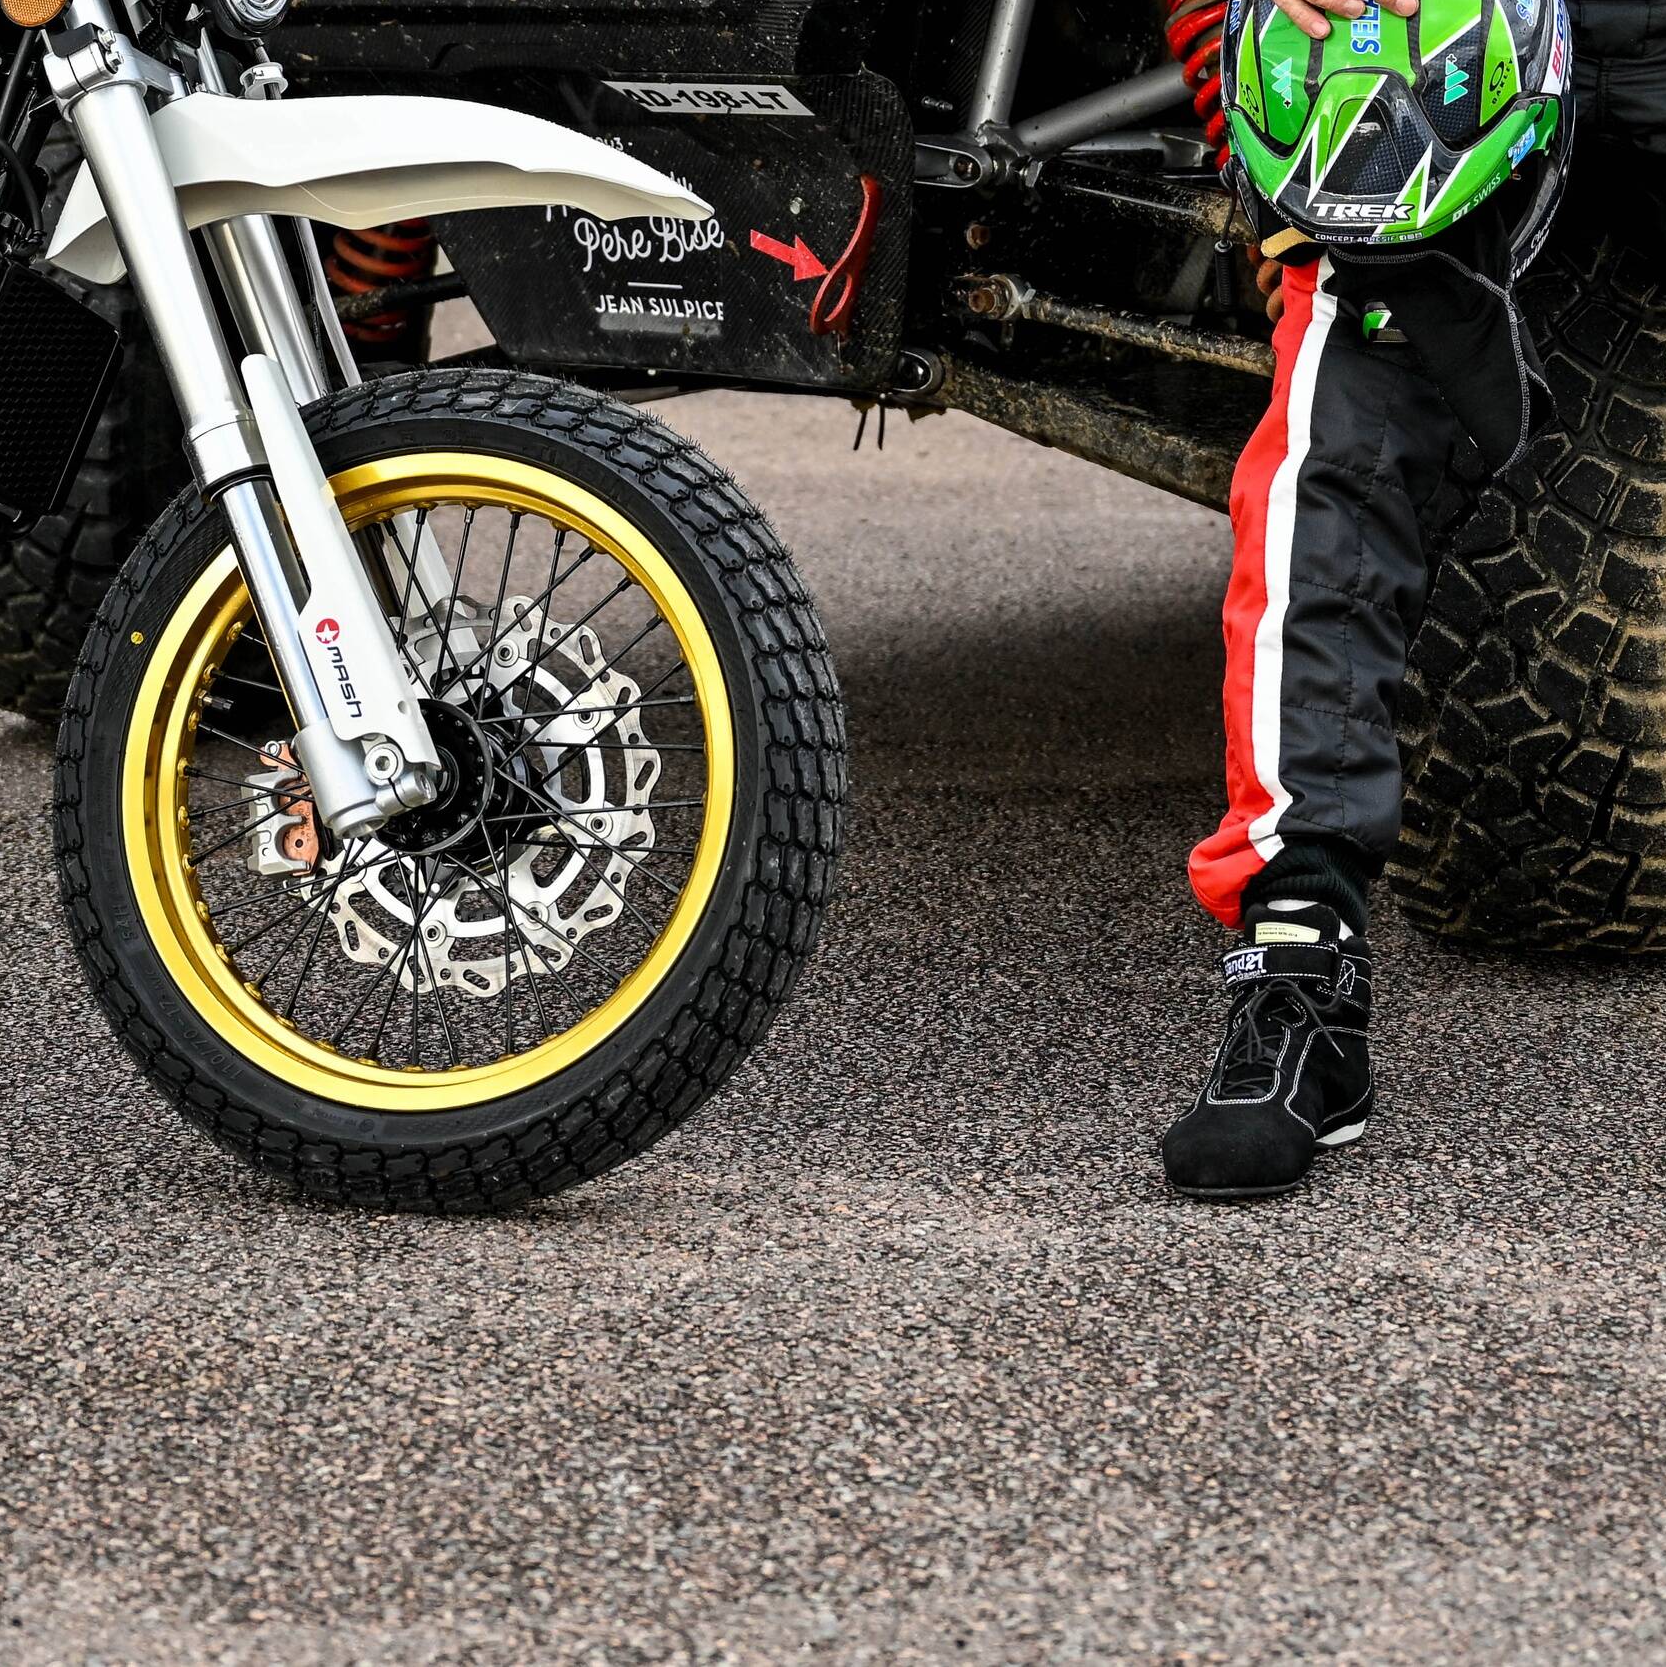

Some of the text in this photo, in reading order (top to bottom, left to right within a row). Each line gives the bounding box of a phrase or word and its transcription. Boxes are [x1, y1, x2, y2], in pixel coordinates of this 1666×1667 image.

[1473, 172, 1501, 207] SWISS
[1312, 203, 1414, 220] TREK
[574, 215, 725, 272] Père Bise
[1315, 233, 1354, 242] CONCEPT
[595, 295, 724, 321] JEAN SULPICE
[327, 645, 363, 718] MASH
